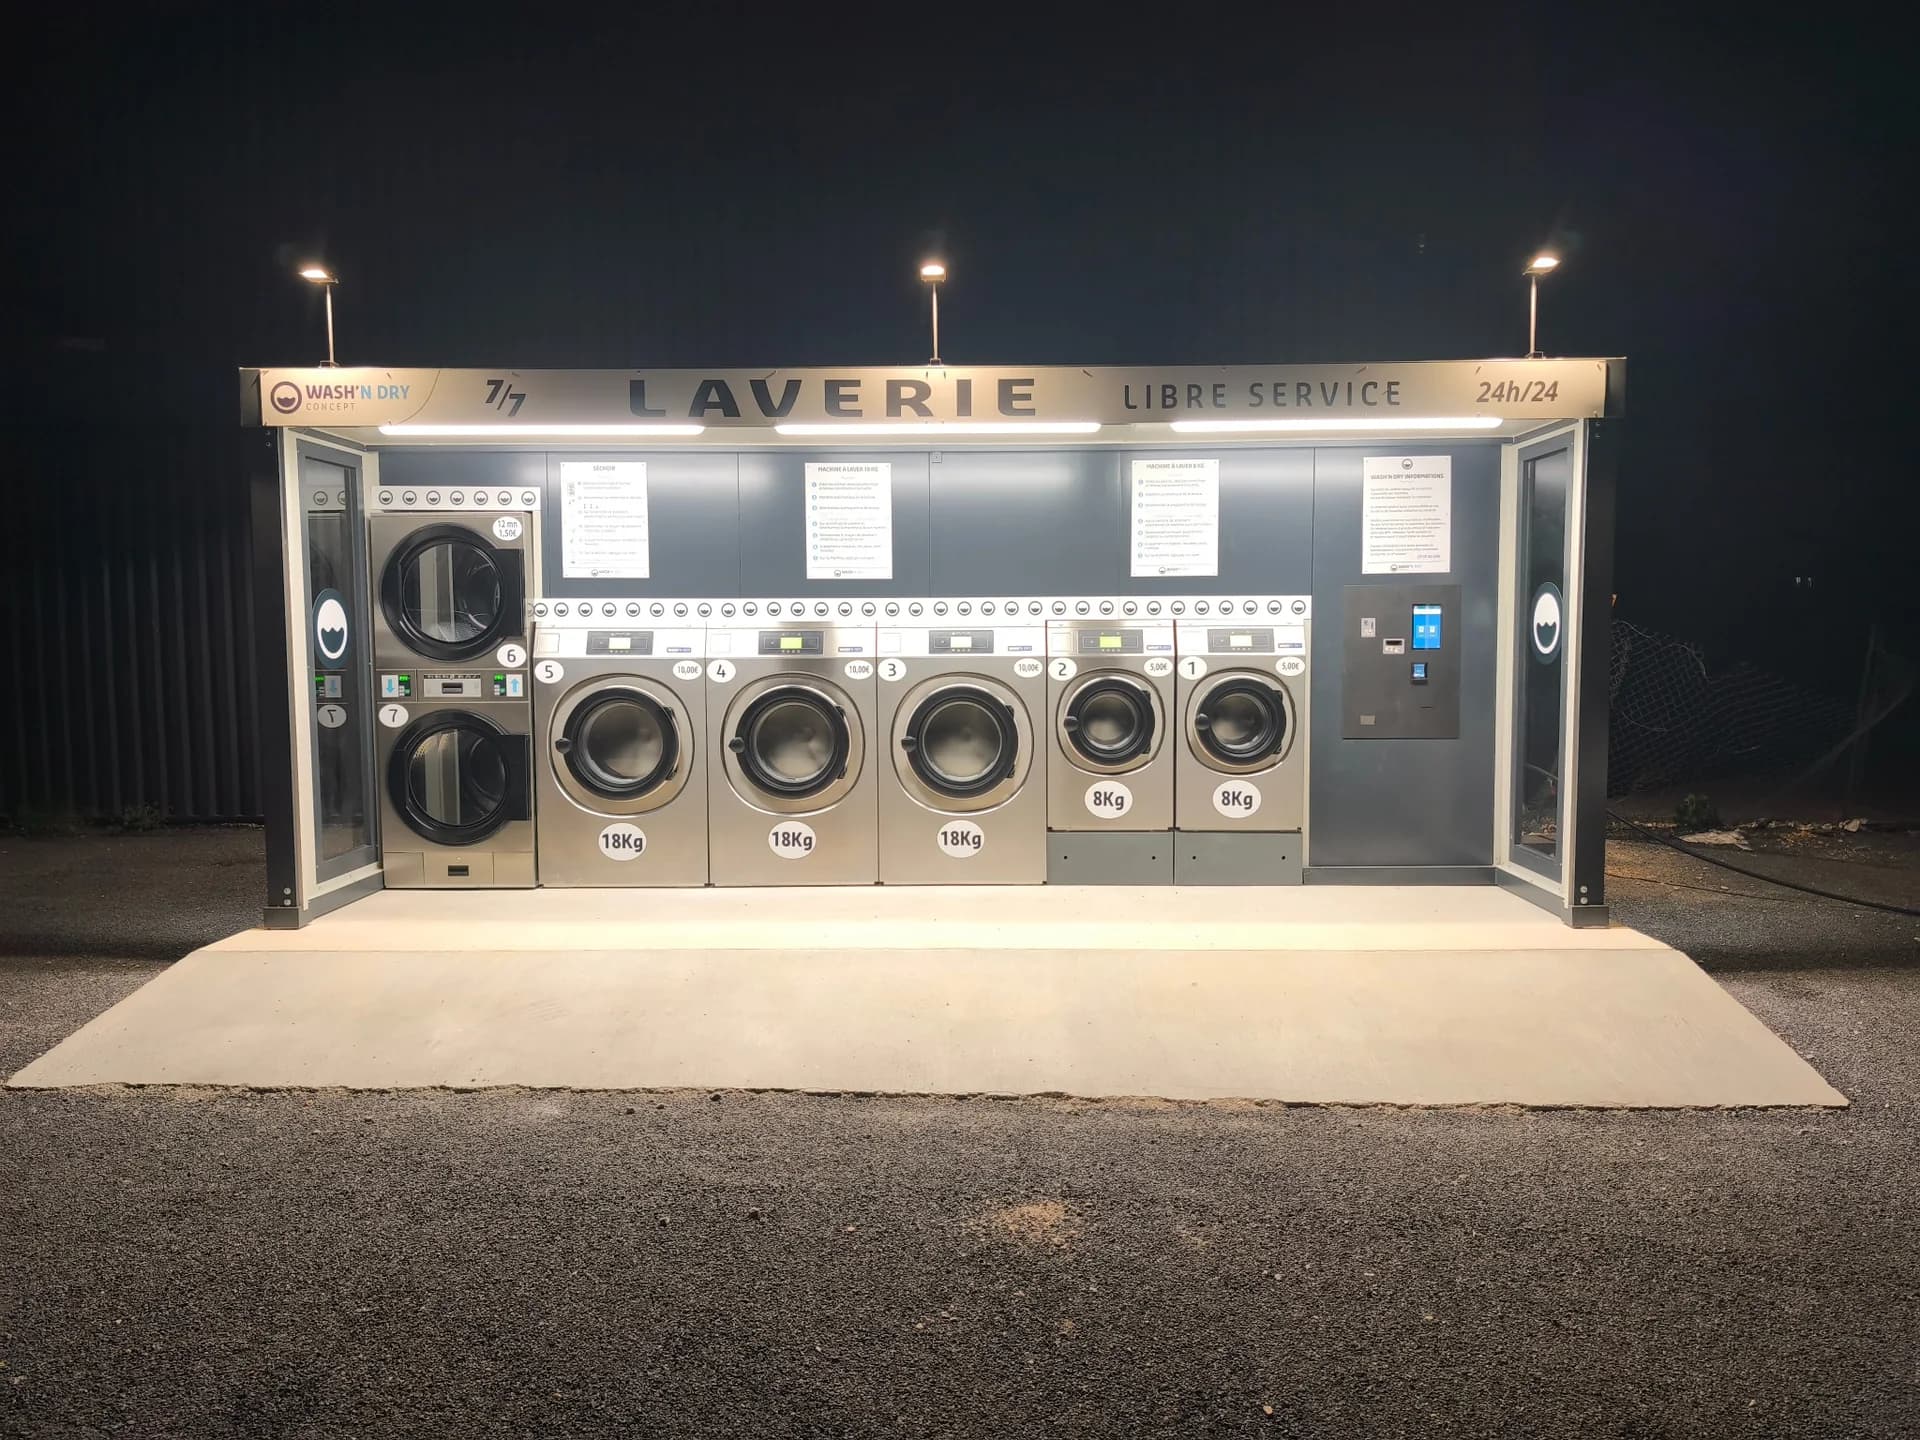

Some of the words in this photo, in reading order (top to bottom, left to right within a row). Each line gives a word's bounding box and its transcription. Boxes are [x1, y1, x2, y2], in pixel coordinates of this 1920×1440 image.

[305, 384, 372, 400] WASH'N
[377, 384, 410, 400] DRY
[486, 379, 526, 418] 7/7
[629, 378, 1037, 418] LAVERIE
[1124, 383, 1227, 410] LIBRE
[1248, 381, 1401, 408] SERVICE
[1476, 380, 1559, 404] 24h/24
[305, 402, 356, 412] CONCEPT
[497, 519, 505, 528] 12
[506, 648, 517, 663] 6
[544, 664, 554, 679] 5
[677, 665, 698, 675] 10,00€
[716, 664, 726, 678] 4
[849, 665, 870, 675] 10,00€
[887, 663, 897, 677] 3
[1018, 663, 1039, 673] 10,00€
[1058, 662, 1067, 676] 2
[1149, 661, 1167, 672] 5,00€
[1187, 661, 1196, 675] 1
[1281, 661, 1299, 671] 5,00€
[388, 709, 398, 723] 7
[1093, 791, 1124, 811] 8Kg
[1221, 790, 1253, 810] 8Kg
[601, 833, 643, 853] 18Kg
[771, 831, 813, 851] 18Kg
[940, 830, 981, 850] 18Kg
